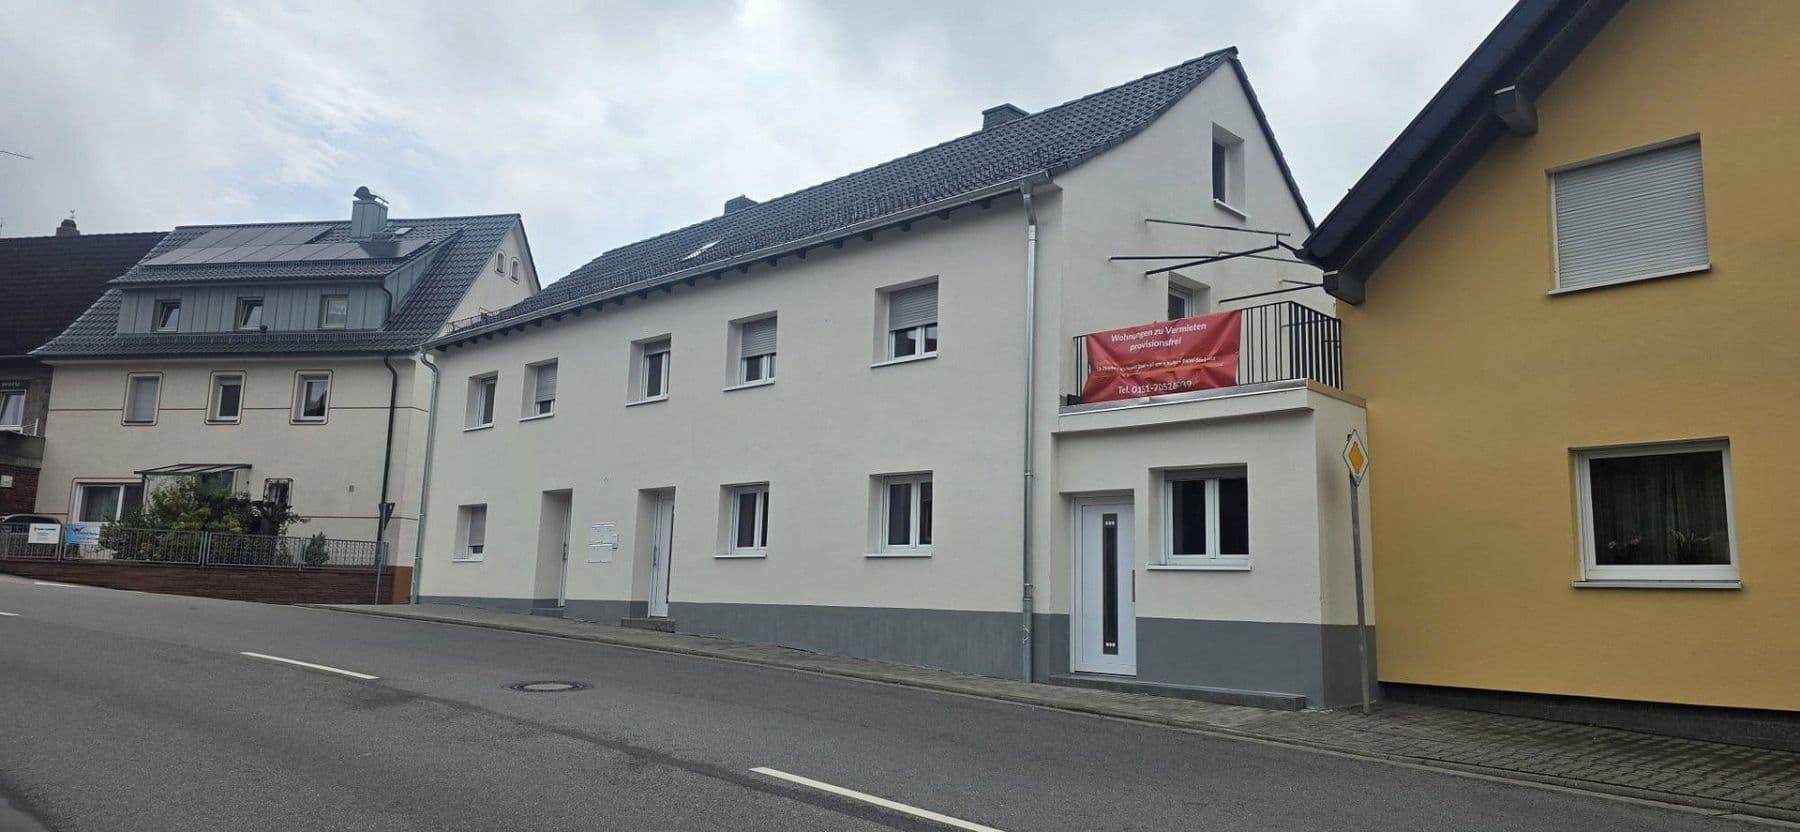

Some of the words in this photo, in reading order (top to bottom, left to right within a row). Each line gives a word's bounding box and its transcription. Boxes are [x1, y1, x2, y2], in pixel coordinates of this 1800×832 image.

[1111, 329, 1152, 342] Wohnungen
[1154, 328, 1164, 336] zu
[1165, 322, 1207, 335] Vermieten
[1129, 337, 1182, 351] provisionsfrei
